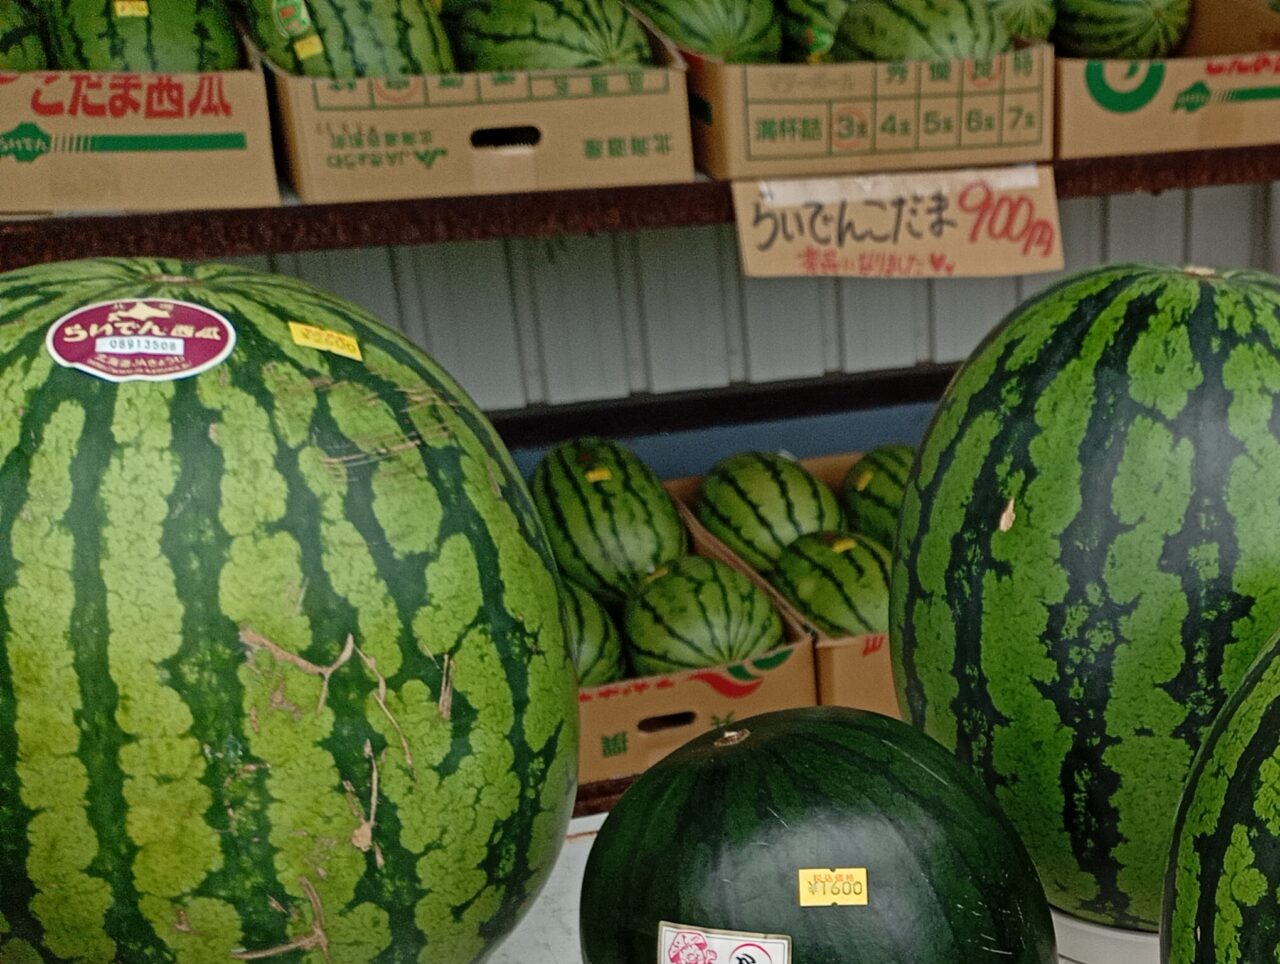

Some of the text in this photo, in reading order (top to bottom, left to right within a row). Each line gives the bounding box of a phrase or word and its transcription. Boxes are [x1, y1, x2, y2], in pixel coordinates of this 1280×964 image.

[752, 190, 957, 251] らいでんこだま
[807, 880, 864, 896] ¥1600
